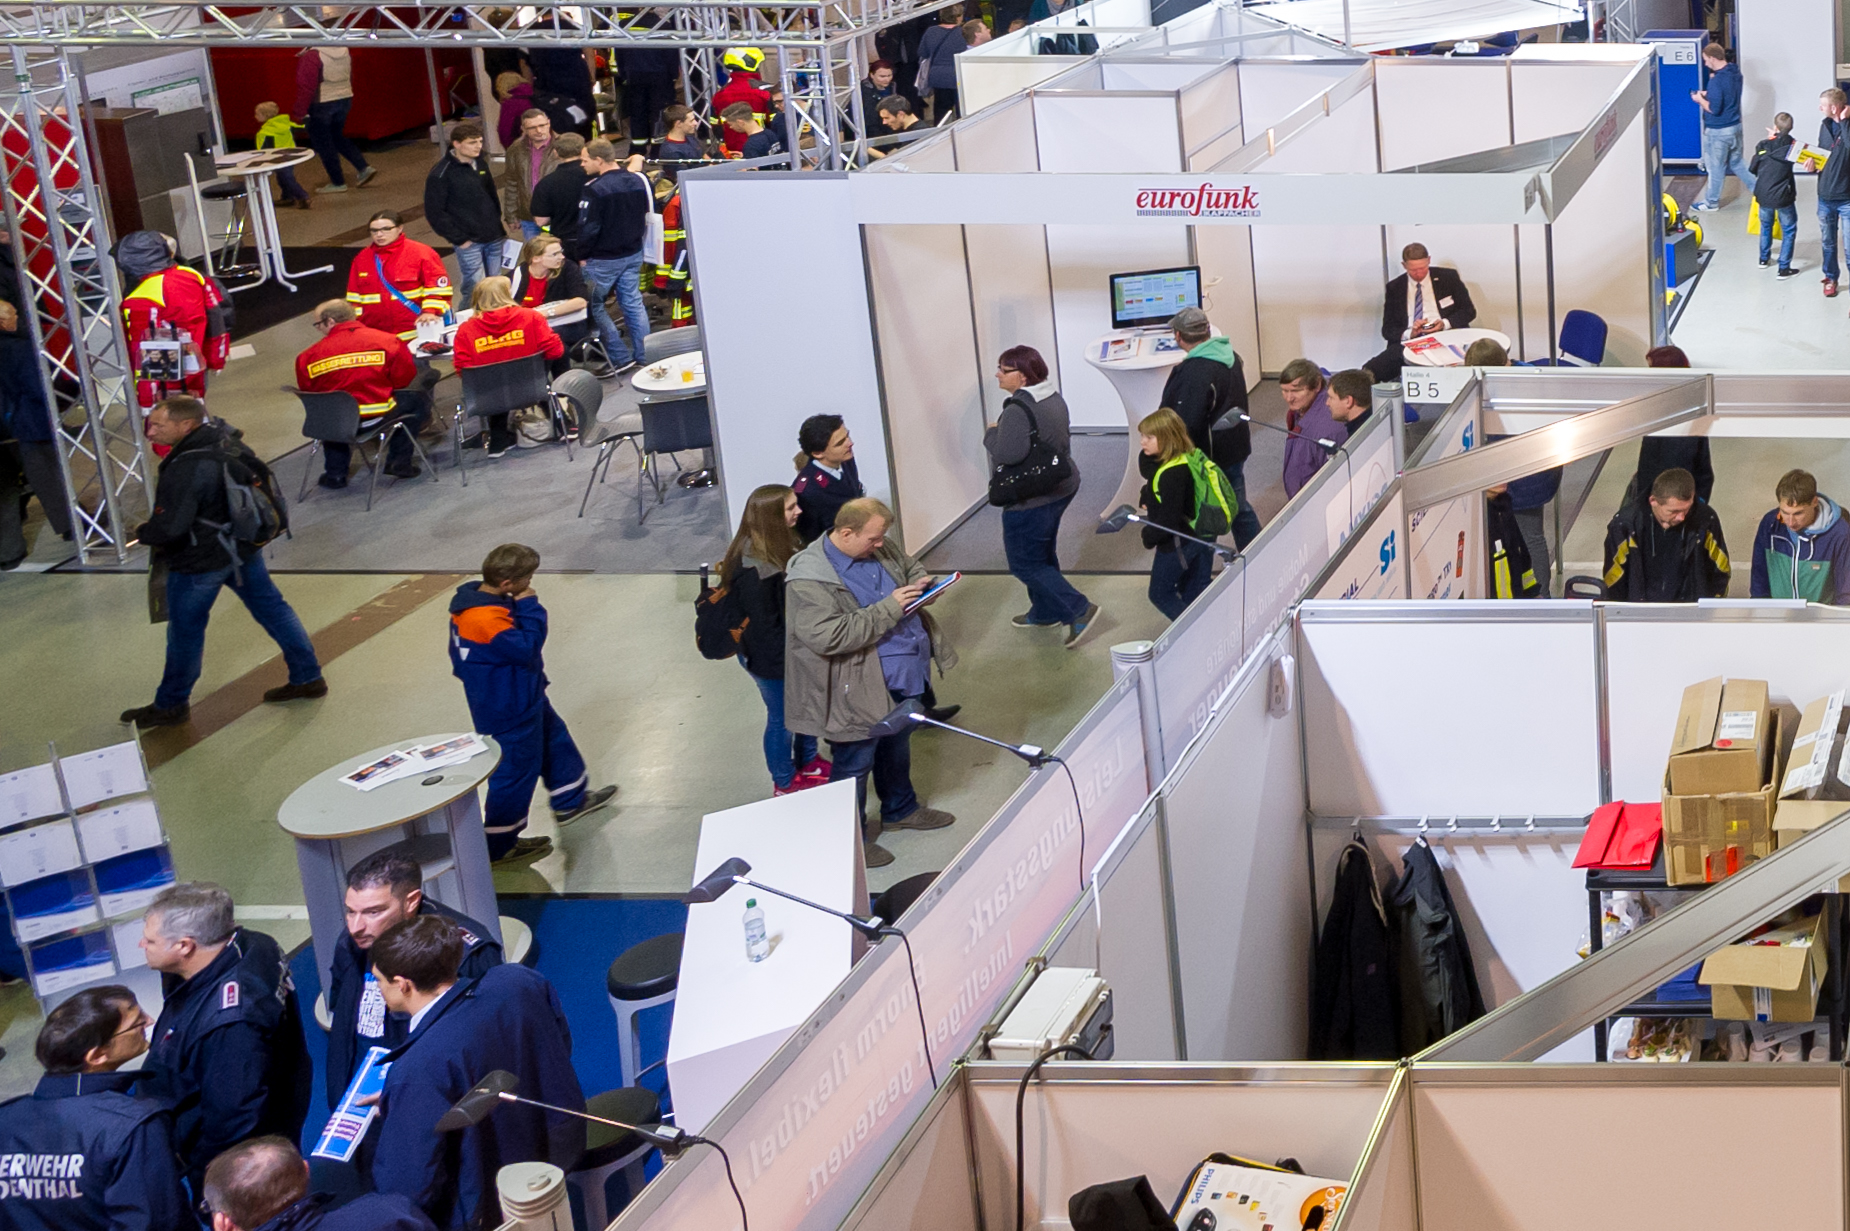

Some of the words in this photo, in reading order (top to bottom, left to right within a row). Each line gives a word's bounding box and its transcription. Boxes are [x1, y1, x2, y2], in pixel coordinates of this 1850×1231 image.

[1675, 51, 1683, 62] E
[1686, 51, 1694, 62] 6
[1136, 182, 1260, 217] eurofunk
[1407, 382, 1421, 398] B
[1427, 382, 1440, 398] 5
[1190, 1168, 1215, 1205] PHILIPS
